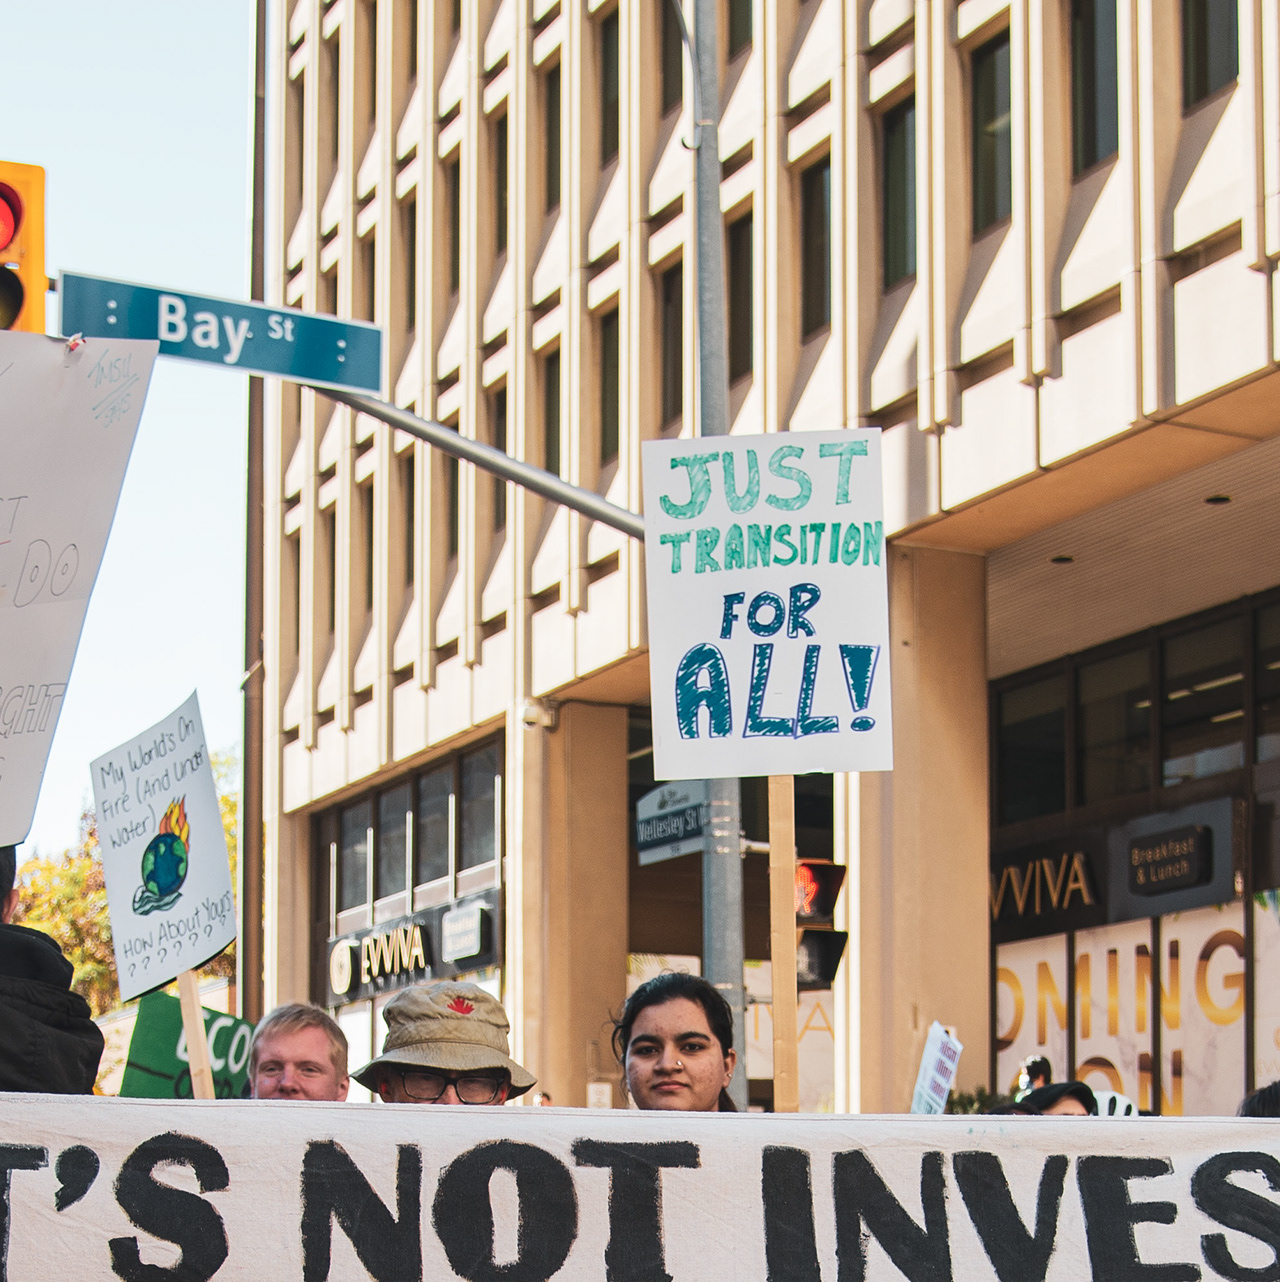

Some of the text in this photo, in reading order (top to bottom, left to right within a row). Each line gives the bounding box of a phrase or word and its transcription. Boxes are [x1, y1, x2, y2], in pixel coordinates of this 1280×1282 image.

[158, 294, 295, 365] Bay St
[659, 440, 869, 519] JUST
[13, 538, 80, 609] DO
[659, 520, 883, 574] TRANSITION
[719, 583, 821, 639] FOR
[675, 642, 881, 740] ALL!
[100, 715, 195, 793] My World's On
[102, 744, 206, 822] Fire (And Under
[637, 814, 684, 843] Wellesley
[1131, 836, 1195, 866] Breakfast
[1150, 859, 1190, 882] Lunch
[123, 890, 232, 960] How About Yours
[361, 925, 426, 984] EVVIVA
